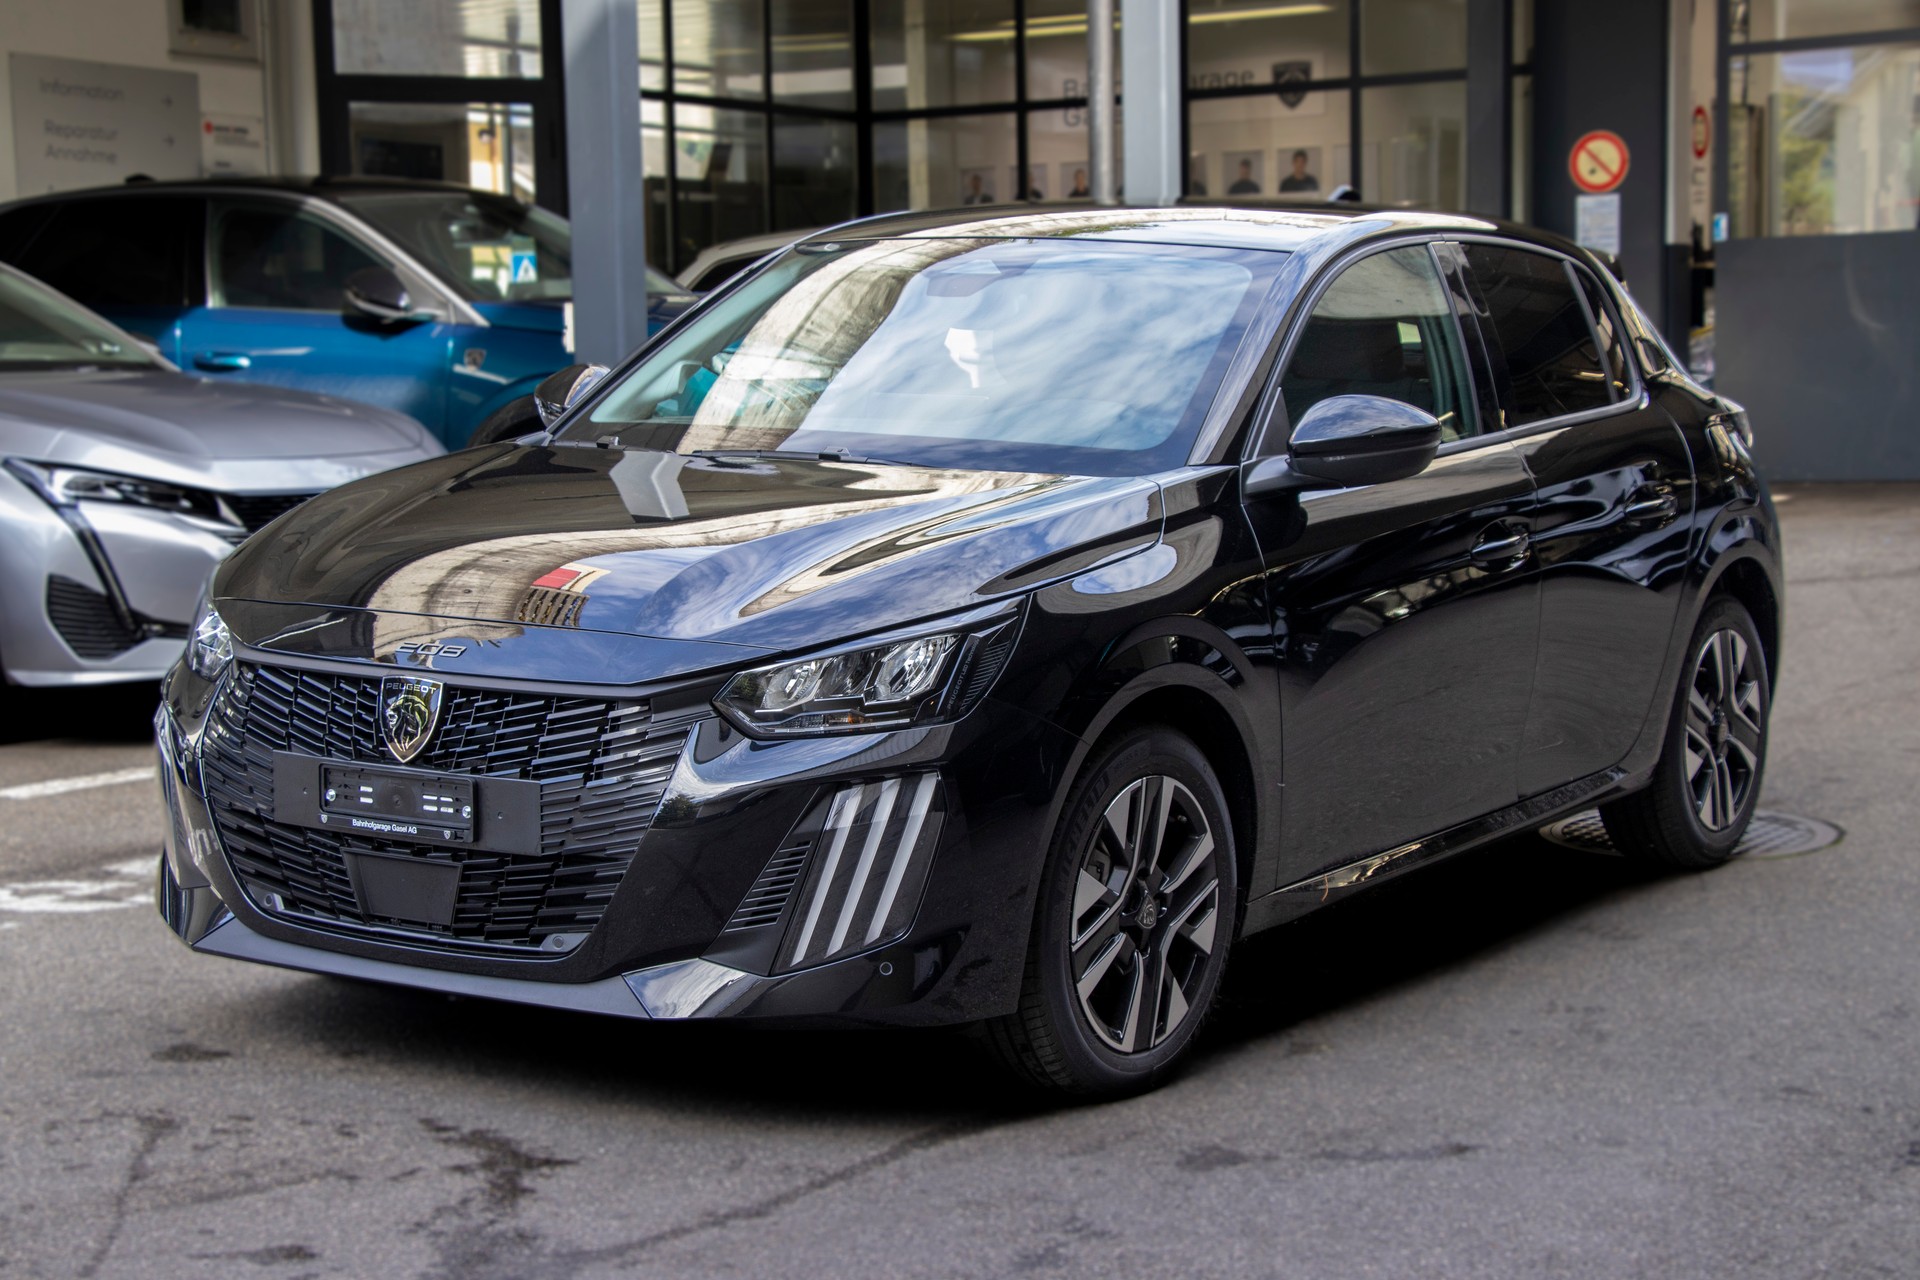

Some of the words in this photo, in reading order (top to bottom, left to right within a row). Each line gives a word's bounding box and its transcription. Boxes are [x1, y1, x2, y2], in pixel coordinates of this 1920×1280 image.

[39, 79, 124, 101] Information
[44, 120, 118, 141] Reparatur
[45, 145, 118, 163] Annahme
[395, 642, 467, 658] 208
[386, 682, 437, 694] PEUGEOT
[946, 675, 965, 711] PEUGEOT
[352, 818, 391, 832] Bahnhofgarage
[392, 824, 407, 833] Gasel
[407, 826, 418, 835] AG
